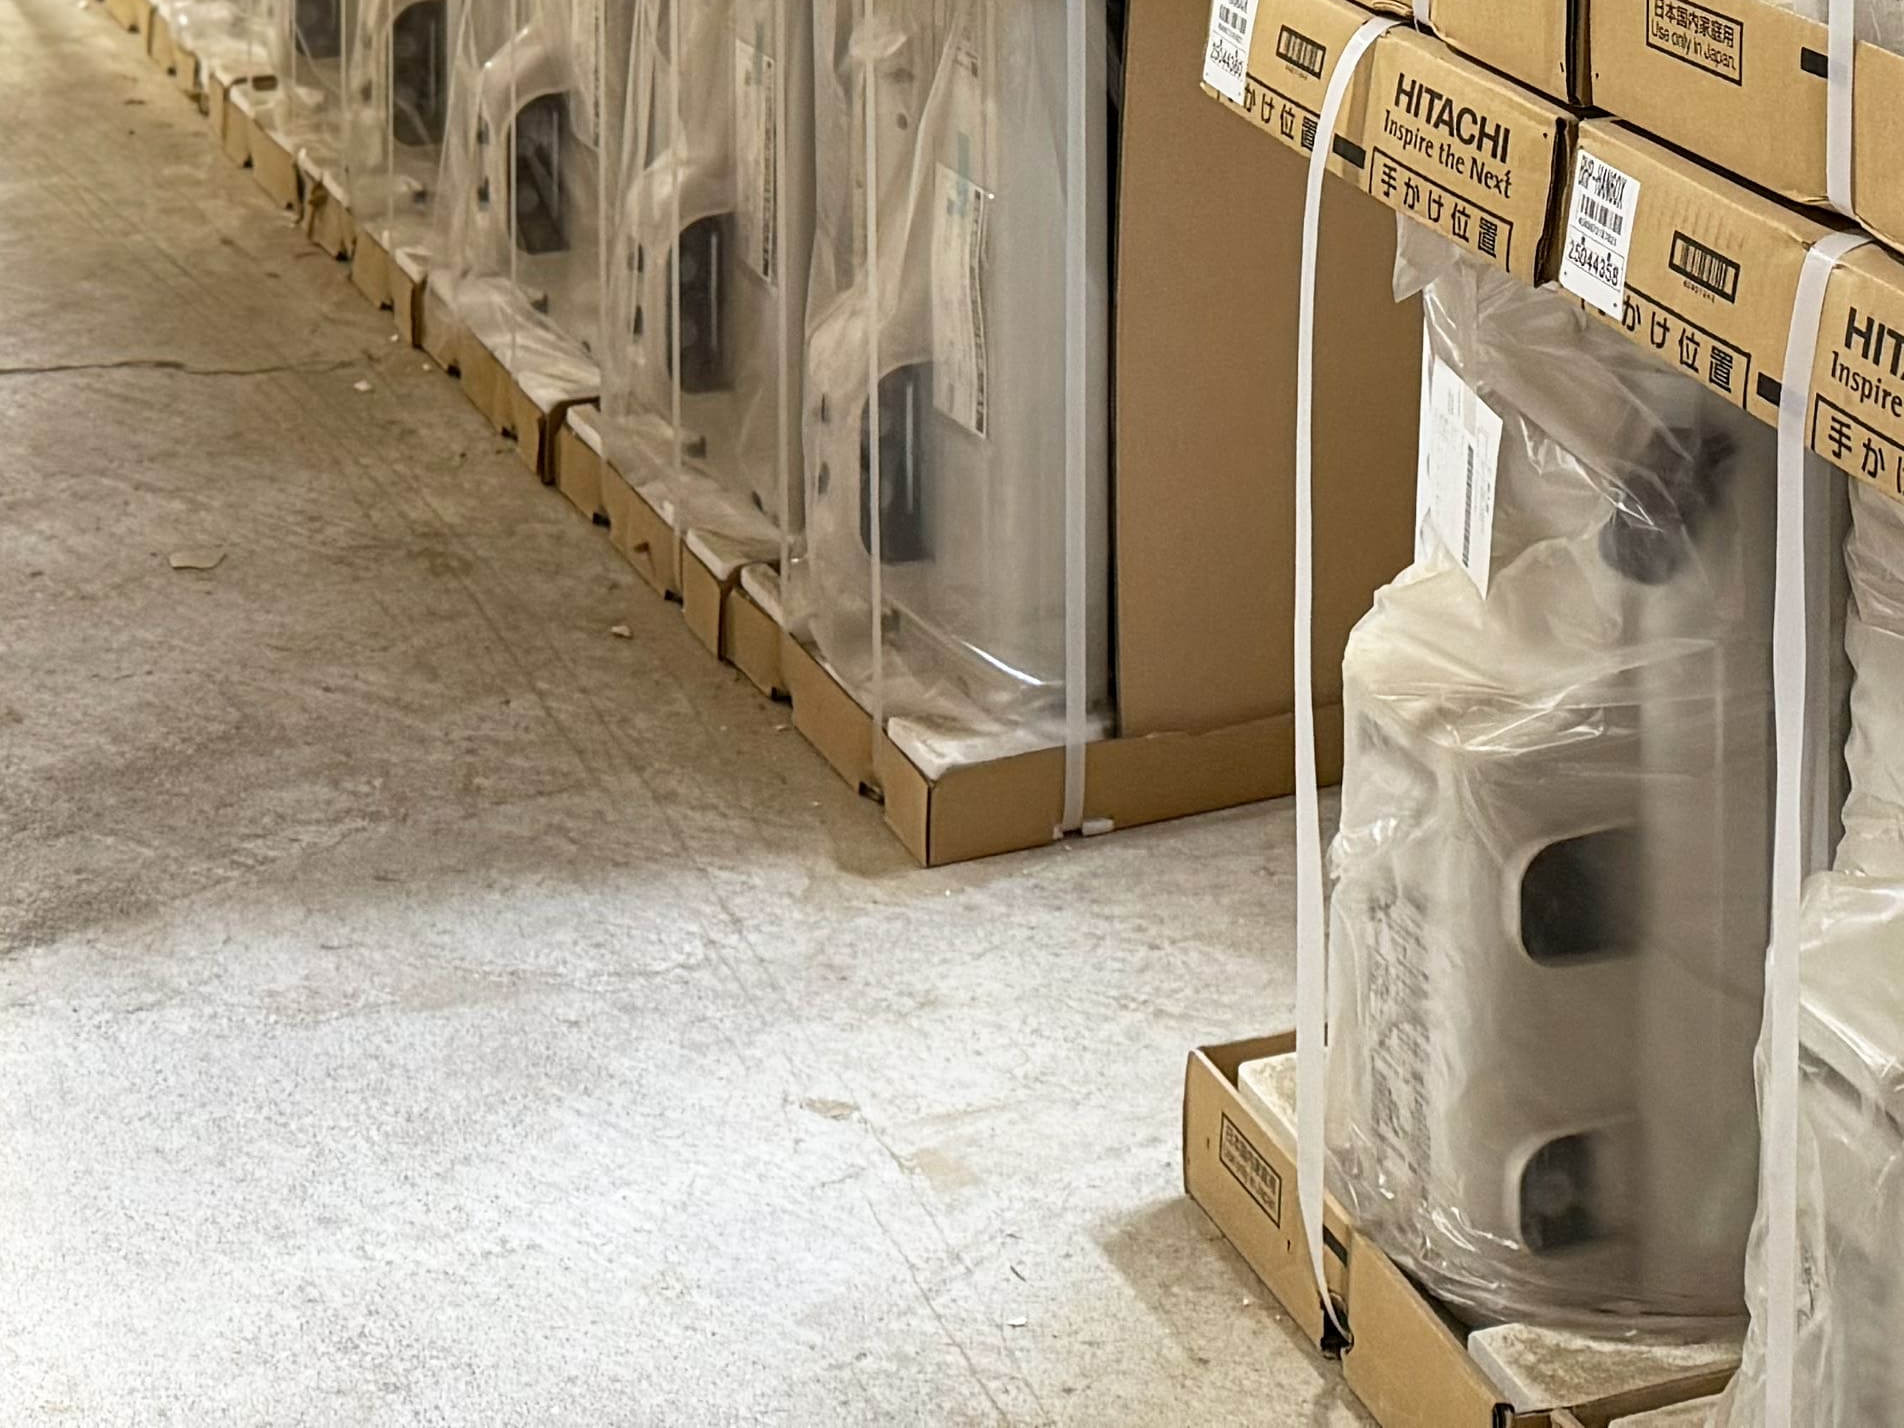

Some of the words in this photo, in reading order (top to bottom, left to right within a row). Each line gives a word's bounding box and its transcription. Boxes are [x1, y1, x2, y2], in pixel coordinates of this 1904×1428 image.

[1650, 18, 1670, 41] Use
[1672, 29, 1692, 55] only
[1693, 38, 1703, 56] in
[1384, 109, 1434, 159] Inspire
[1438, 142, 1465, 176] the
[1469, 158, 1514, 199] Next
[1393, 72, 1511, 165] HITACHI
[1381, 164, 1499, 259] 手かけ位置
[1831, 349, 1902, 420] Inspire
